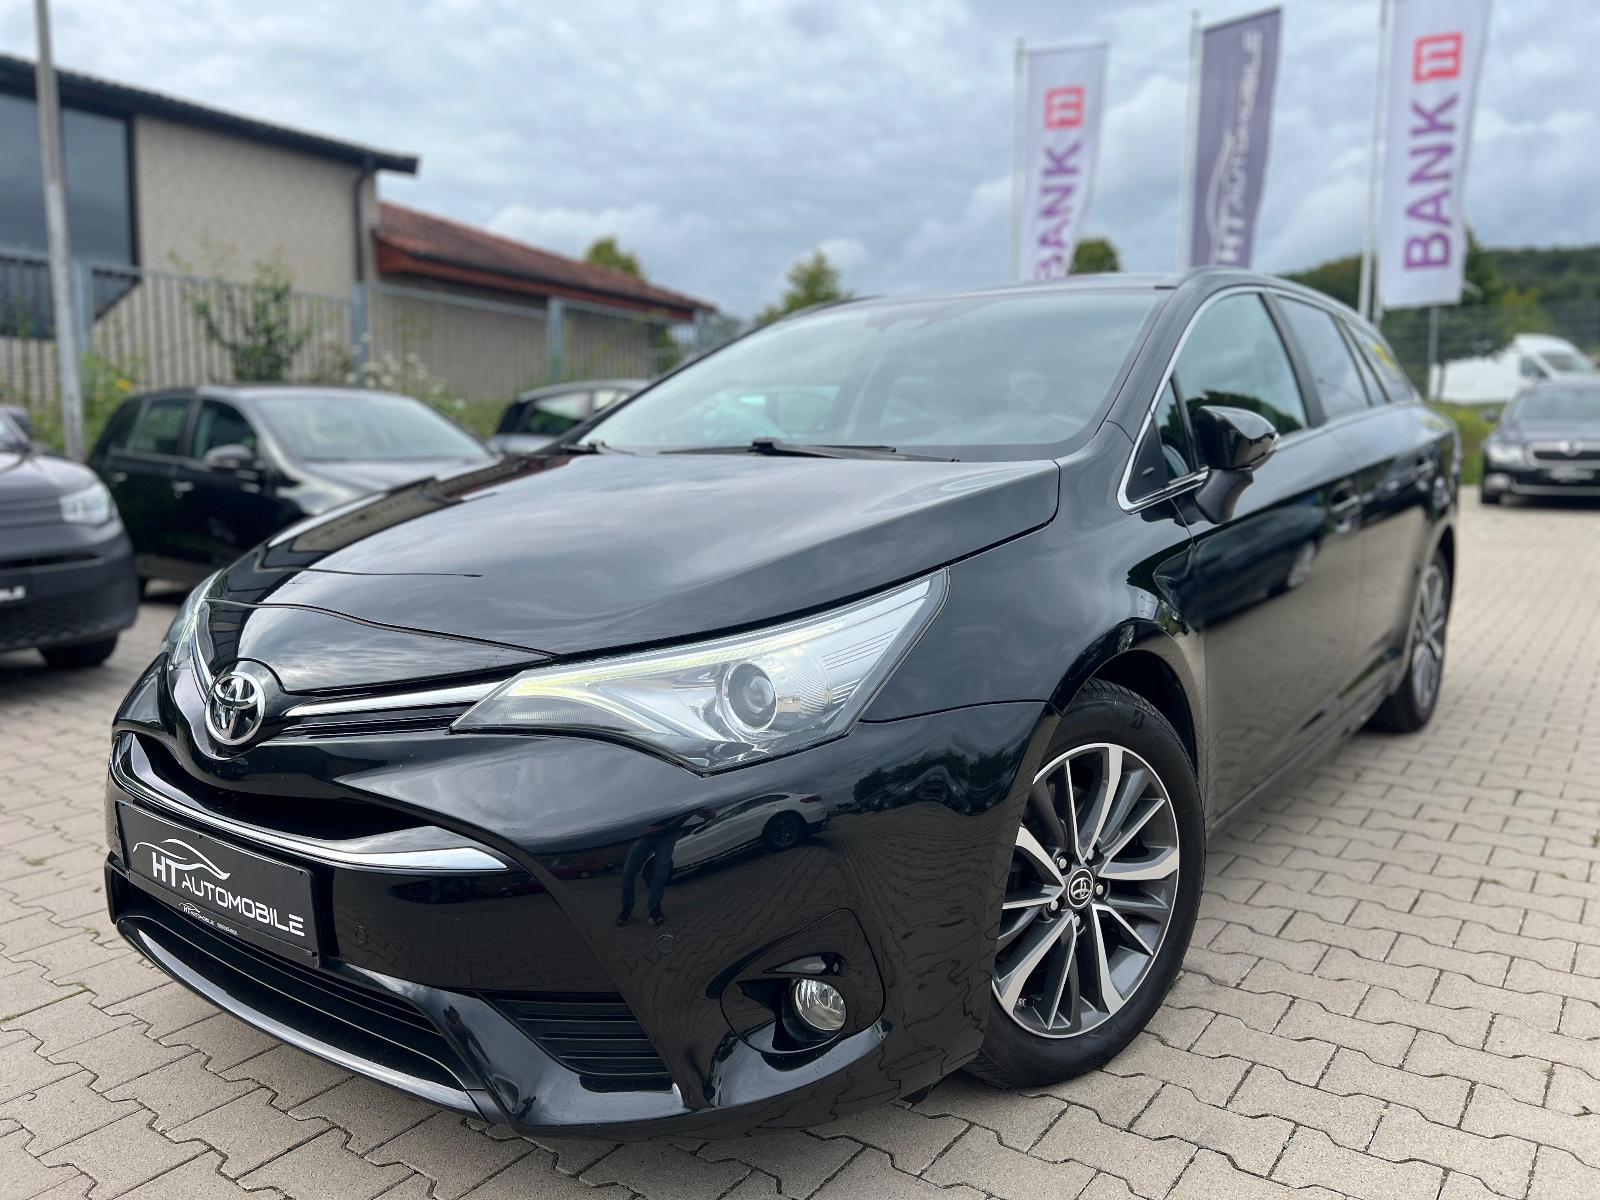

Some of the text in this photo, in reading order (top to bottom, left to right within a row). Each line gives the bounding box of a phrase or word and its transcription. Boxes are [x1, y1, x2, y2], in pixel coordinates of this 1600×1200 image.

[1034, 142, 1083, 280] BANK
[1404, 95, 1458, 271] BANK
[152, 852, 305, 937] HT AUTOMOBILE
